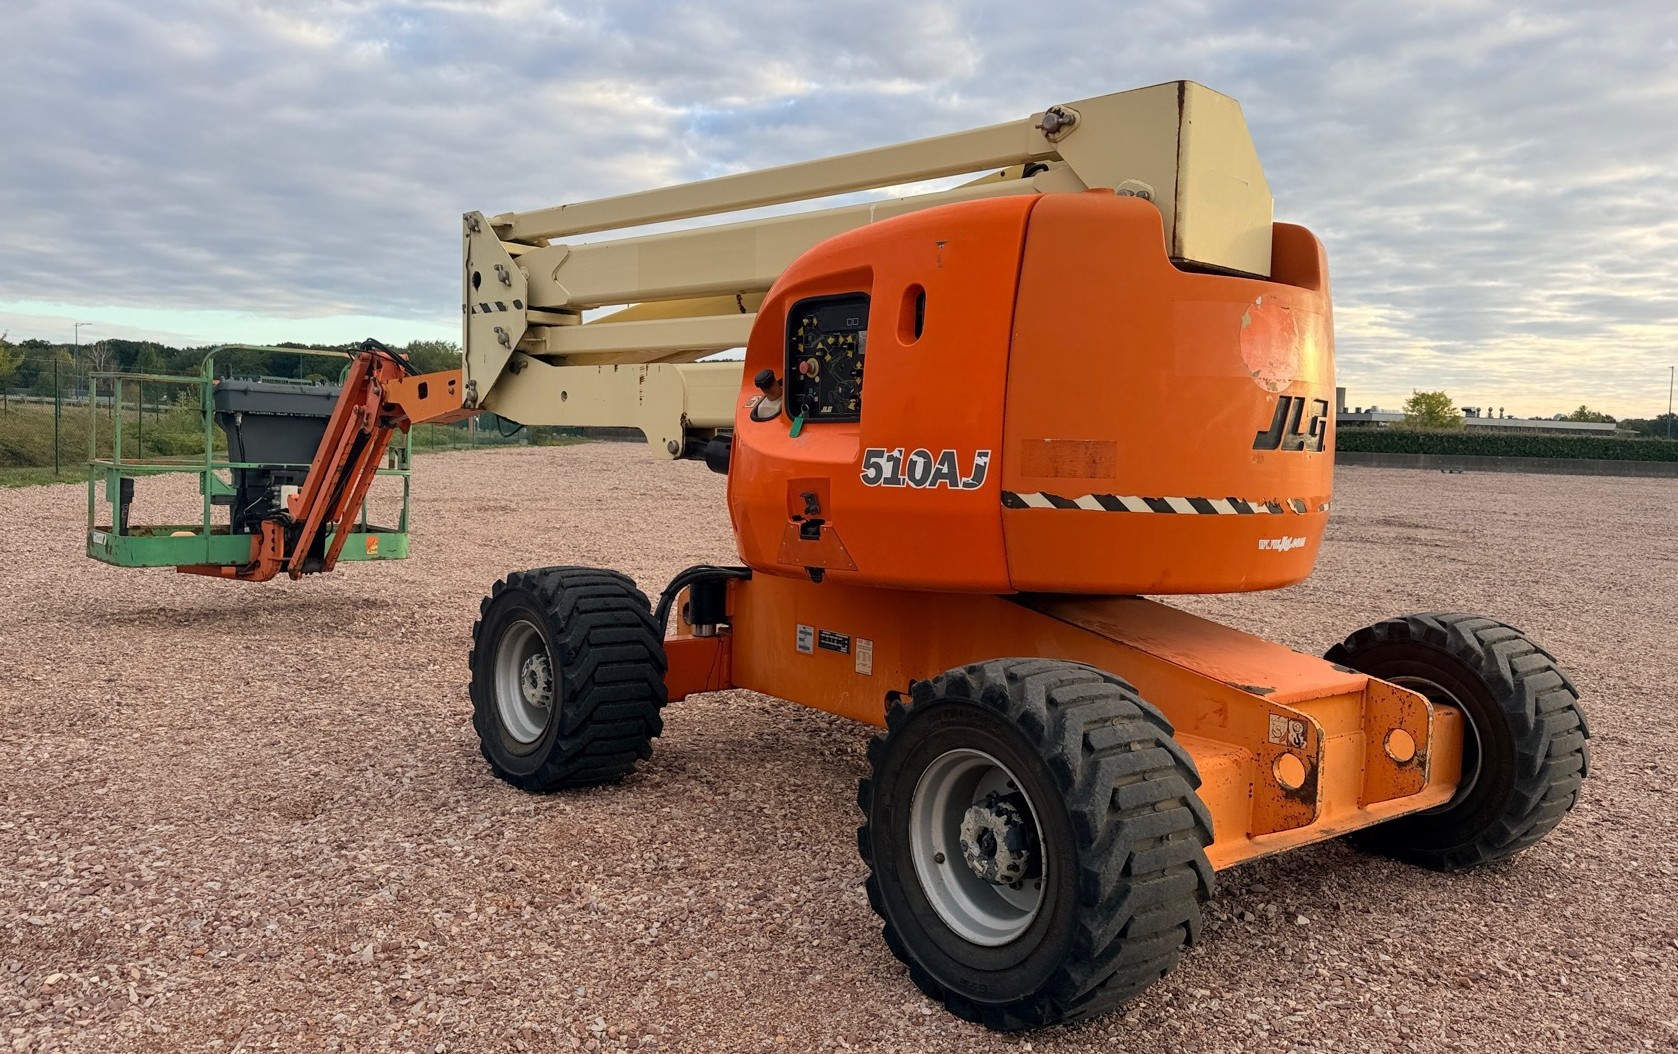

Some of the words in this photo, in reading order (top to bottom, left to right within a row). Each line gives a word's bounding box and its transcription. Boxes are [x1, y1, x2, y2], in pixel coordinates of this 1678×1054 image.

[820, 405, 833, 413] JLG
[1252, 395, 1329, 452] JLG
[860, 448, 992, 490] 510AJ
